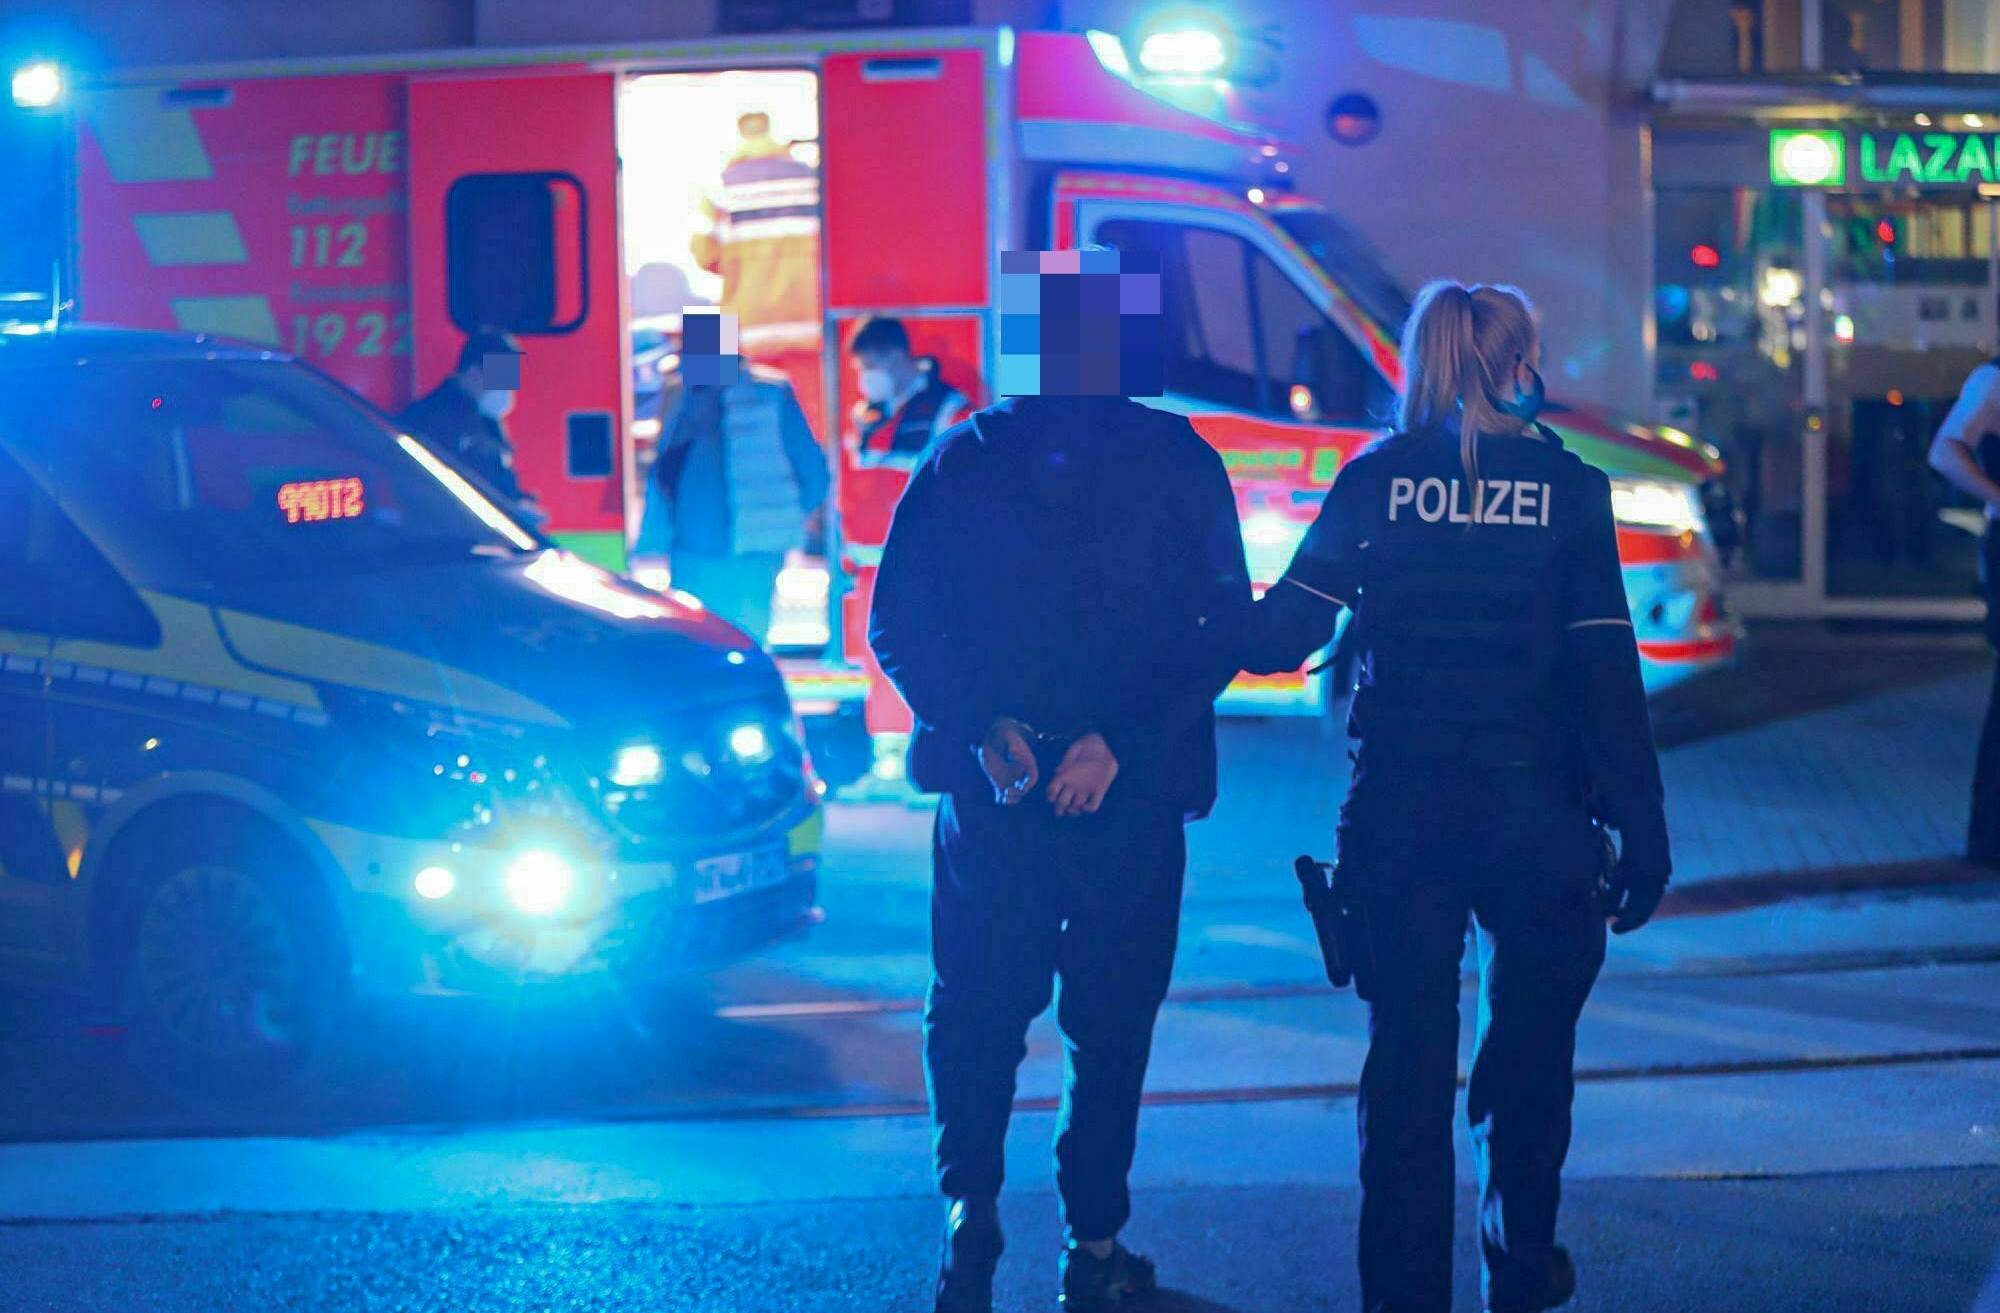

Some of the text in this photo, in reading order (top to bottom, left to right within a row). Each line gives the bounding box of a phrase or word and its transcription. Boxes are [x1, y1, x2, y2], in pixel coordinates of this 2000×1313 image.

[1860, 133, 2000, 183] LAZA
[290, 224, 368, 268] 112
[1388, 477, 1552, 527] POLIZEI
